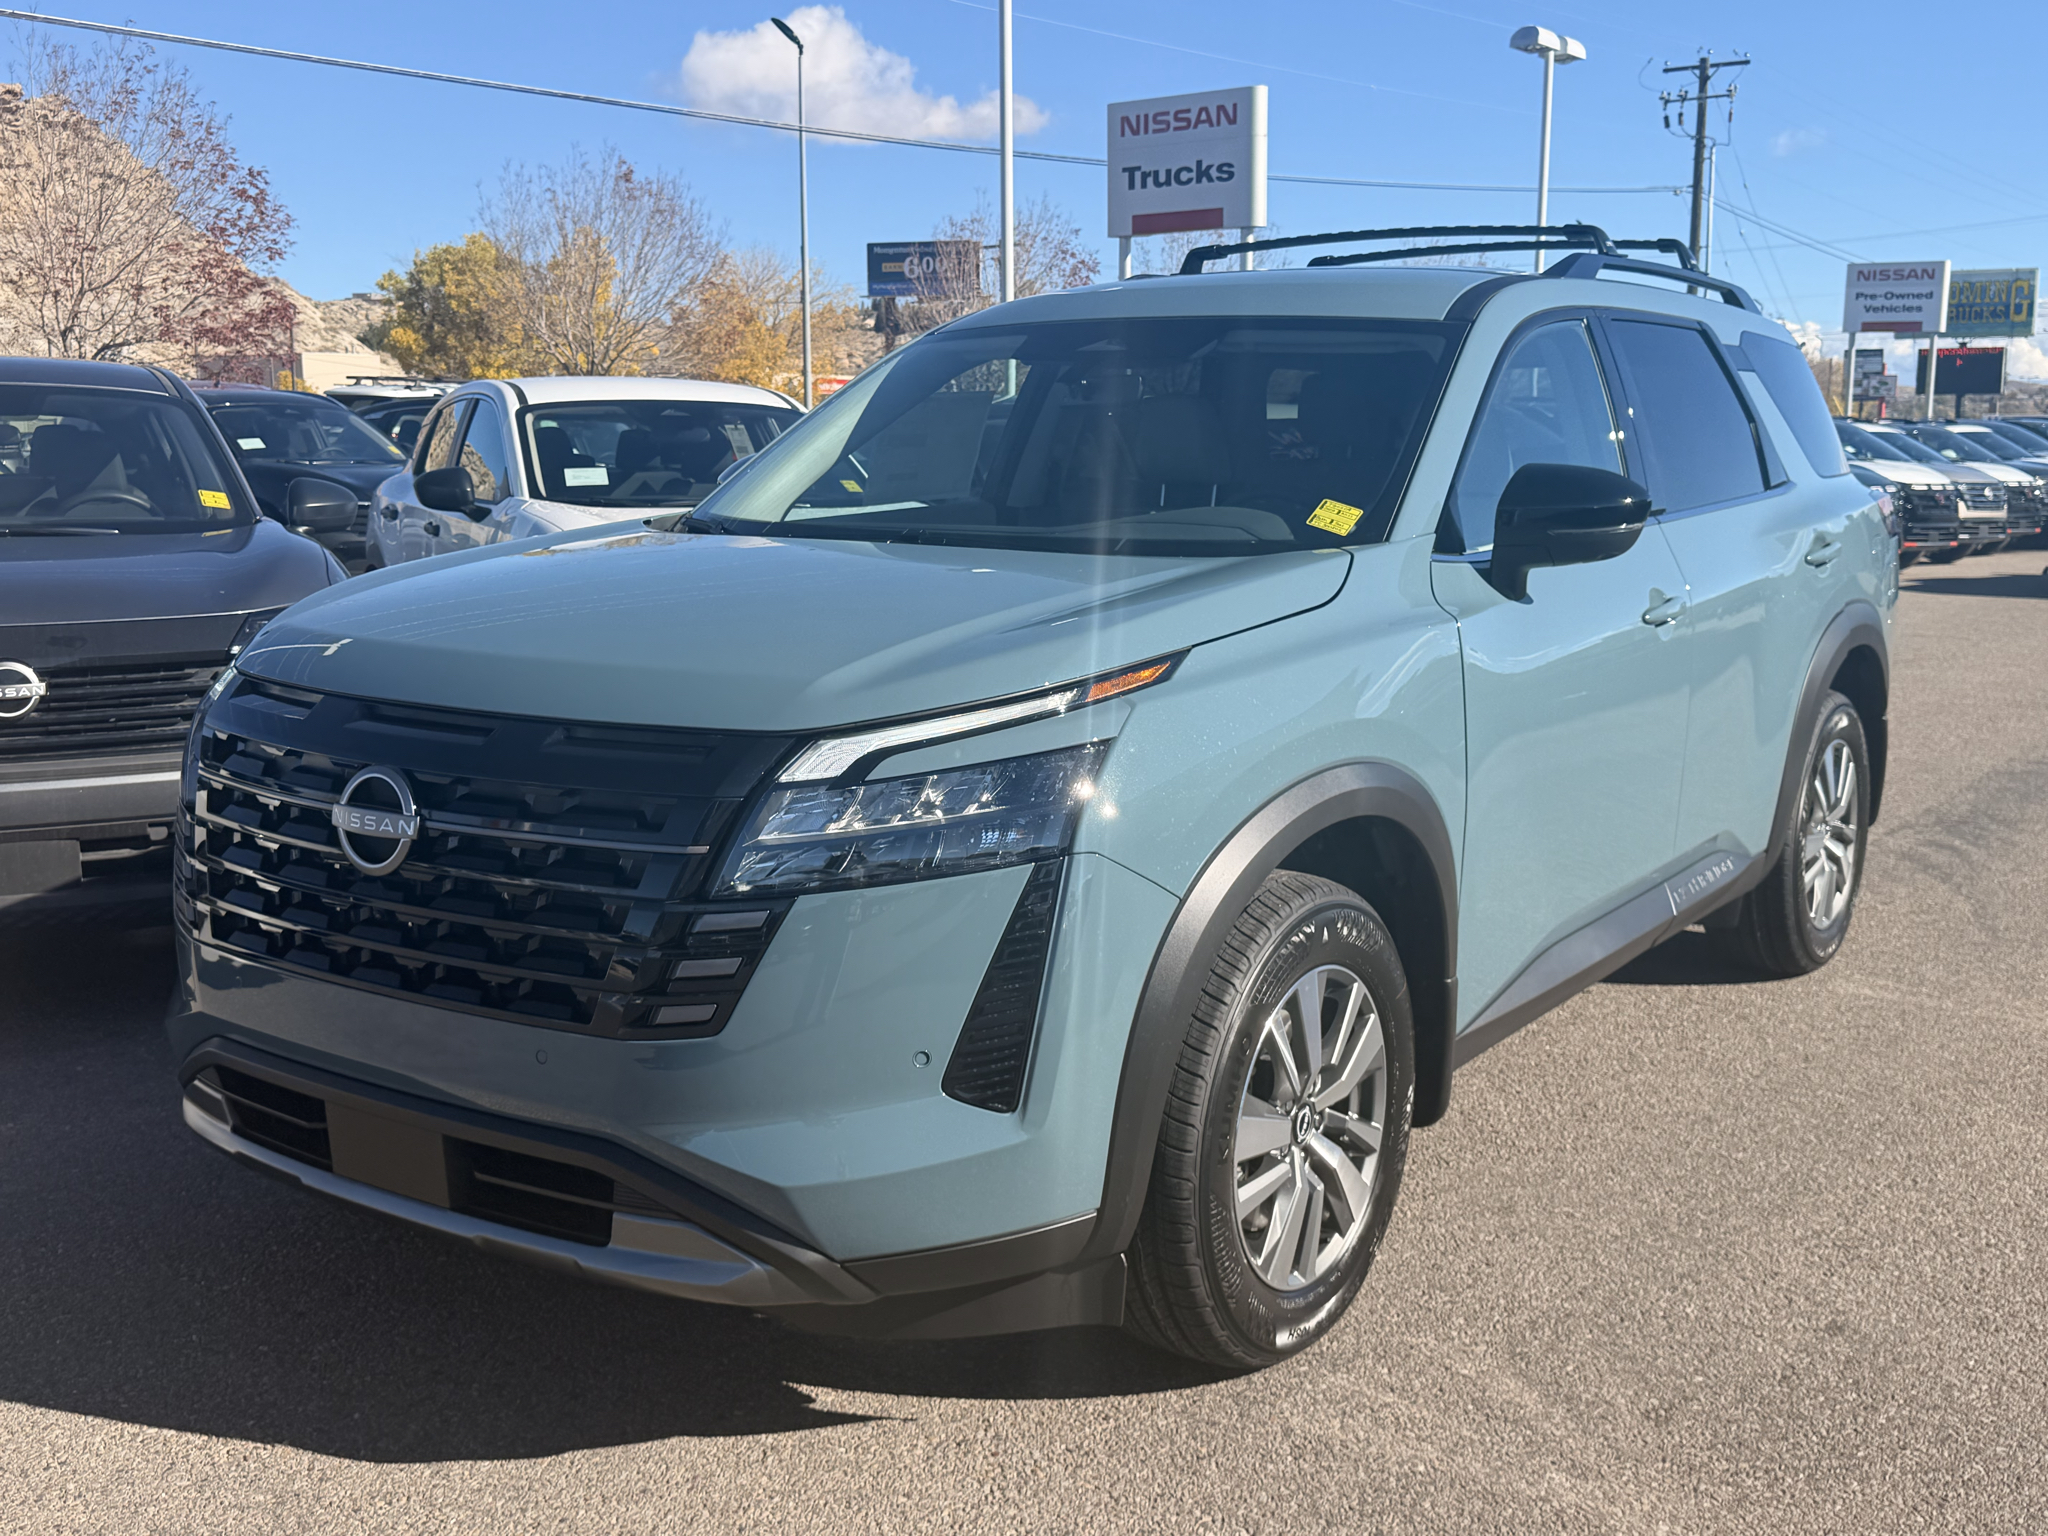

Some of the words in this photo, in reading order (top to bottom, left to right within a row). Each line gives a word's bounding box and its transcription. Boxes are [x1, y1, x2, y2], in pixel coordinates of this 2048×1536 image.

[1120, 103, 1237, 137] NISSAN
[1122, 160, 1235, 191] Trucks
[1856, 268, 1936, 282] NISSAN
[1855, 290, 1934, 301] Pre-Owned
[1863, 304, 1924, 314] Vehicles
[1948, 305, 2007, 324] RUCKS
[333, 807, 415, 836] NISSAN
